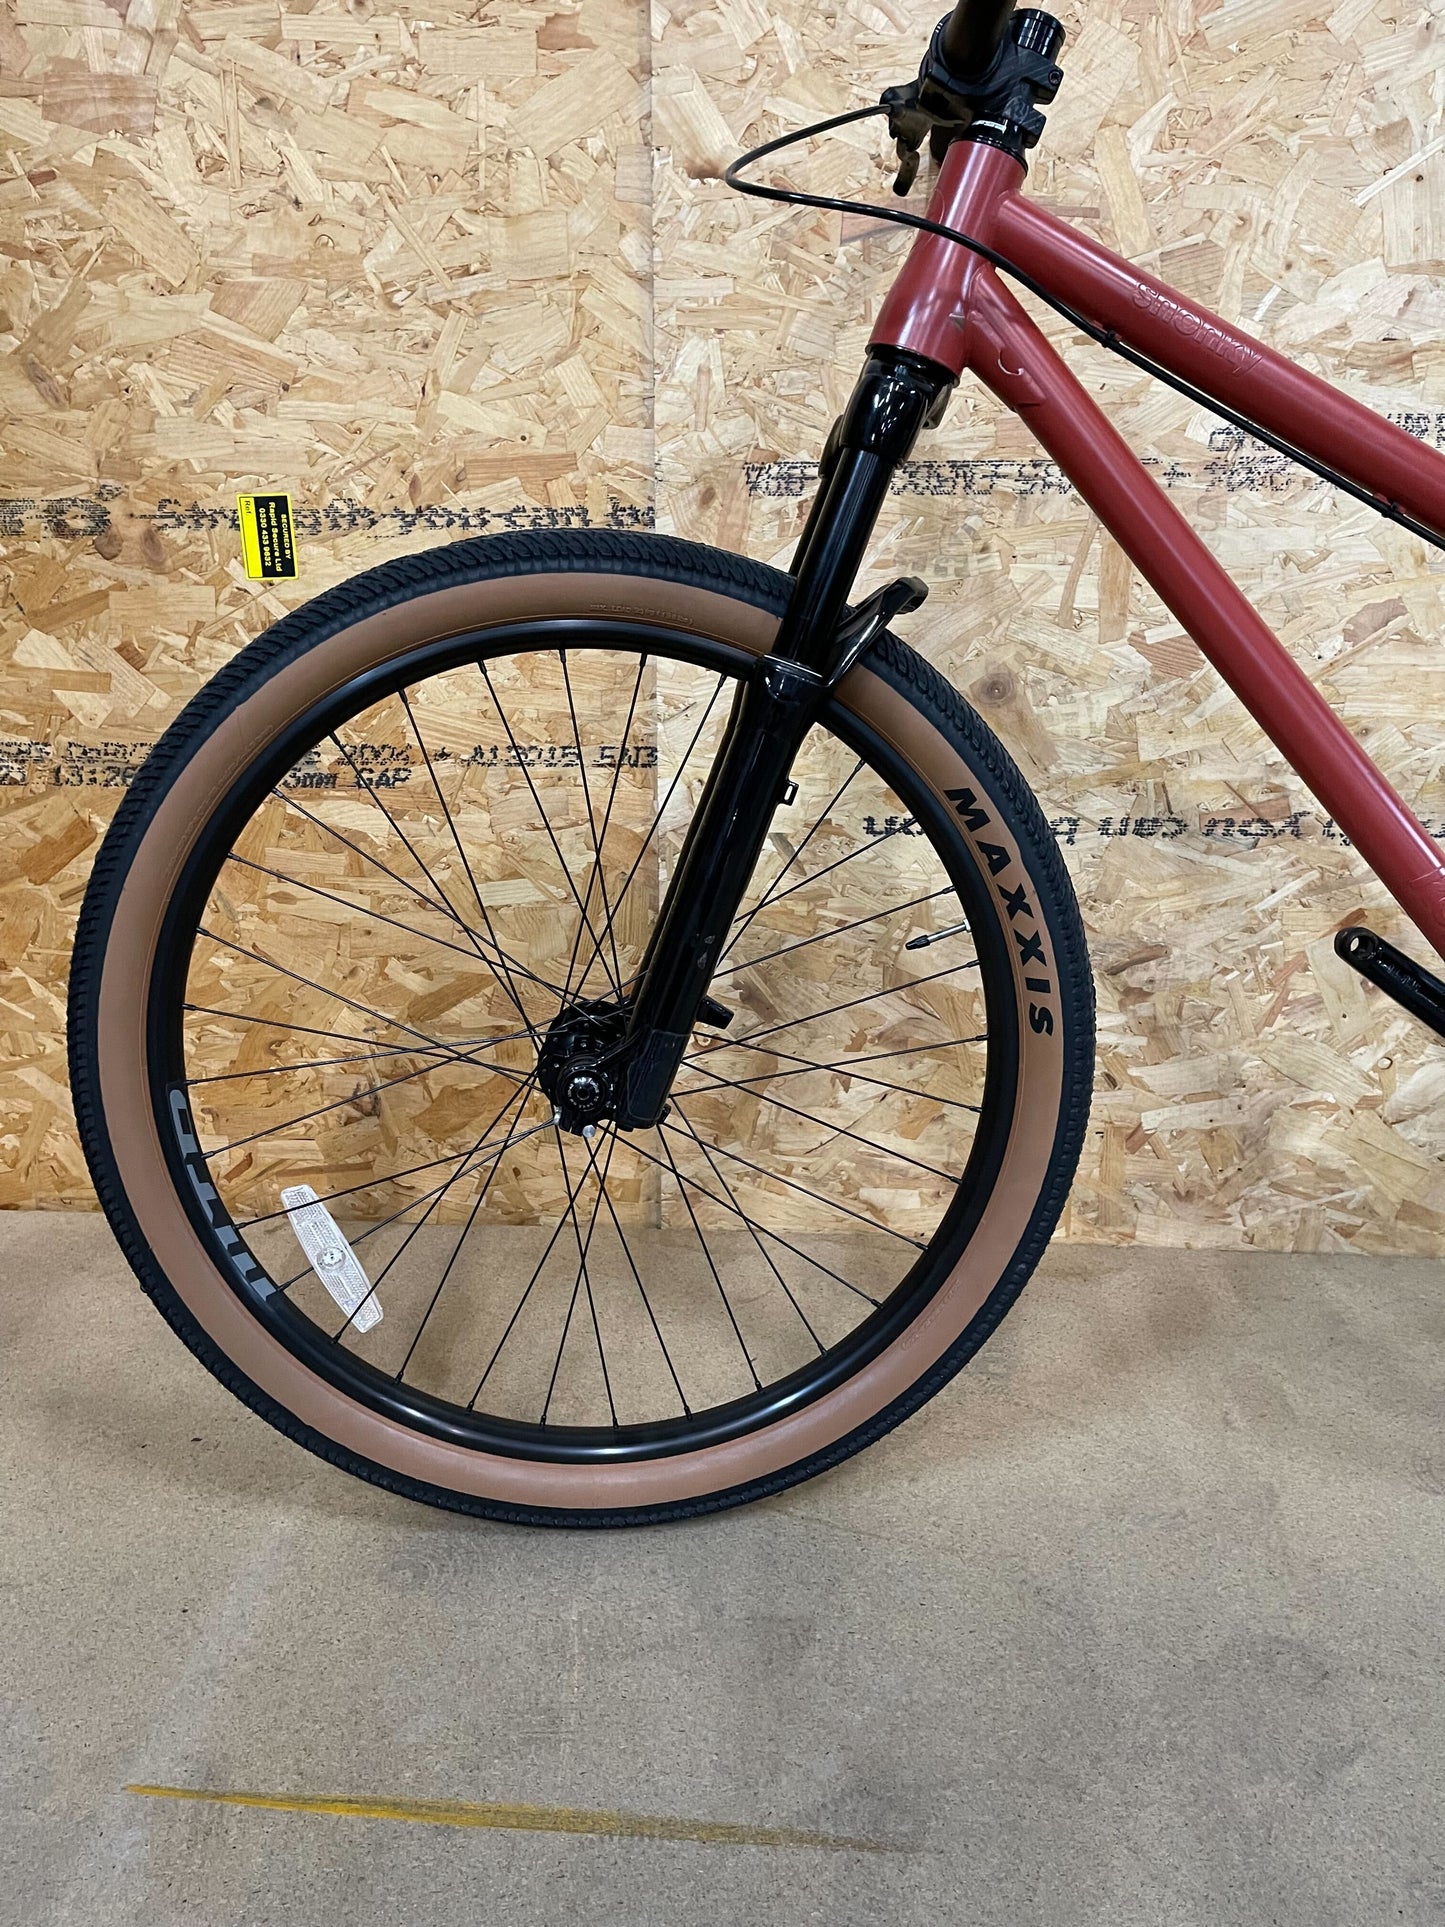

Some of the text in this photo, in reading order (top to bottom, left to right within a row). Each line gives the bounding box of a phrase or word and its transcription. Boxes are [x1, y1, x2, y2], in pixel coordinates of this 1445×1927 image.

[268, 502, 283, 572] Rapid Secure Ltd
[281, 514, 291, 549] SECURED
[944, 787, 1053, 1037] MAXXIS
